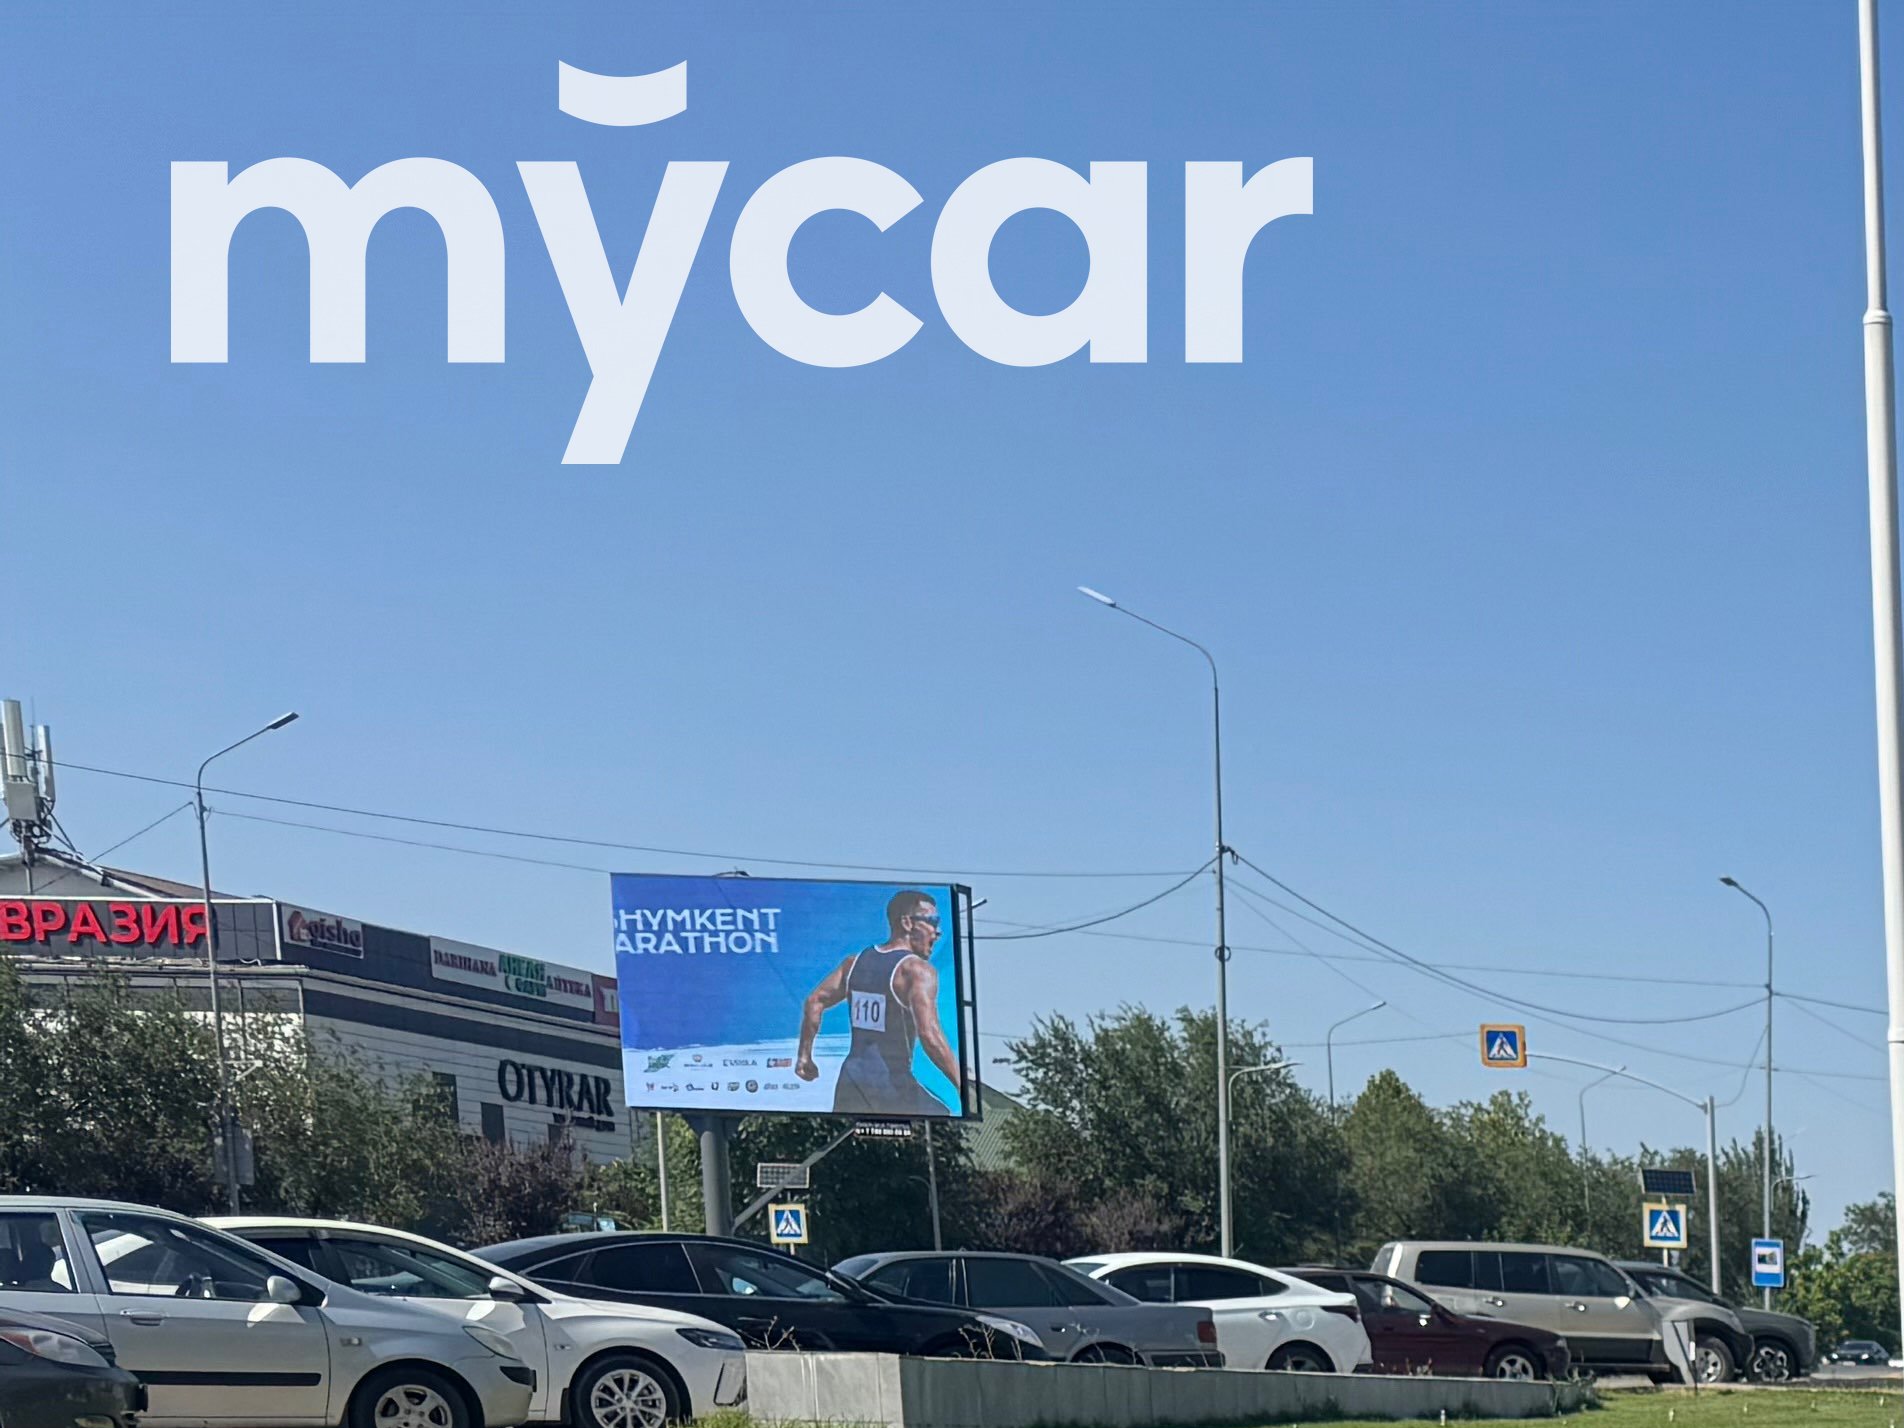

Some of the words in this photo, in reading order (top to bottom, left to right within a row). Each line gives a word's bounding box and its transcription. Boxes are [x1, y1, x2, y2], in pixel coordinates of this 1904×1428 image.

[613, 908, 782, 932] HYMKENT
[854, 999, 880, 1023] 110
[498, 1058, 615, 1117] OTYRAR
